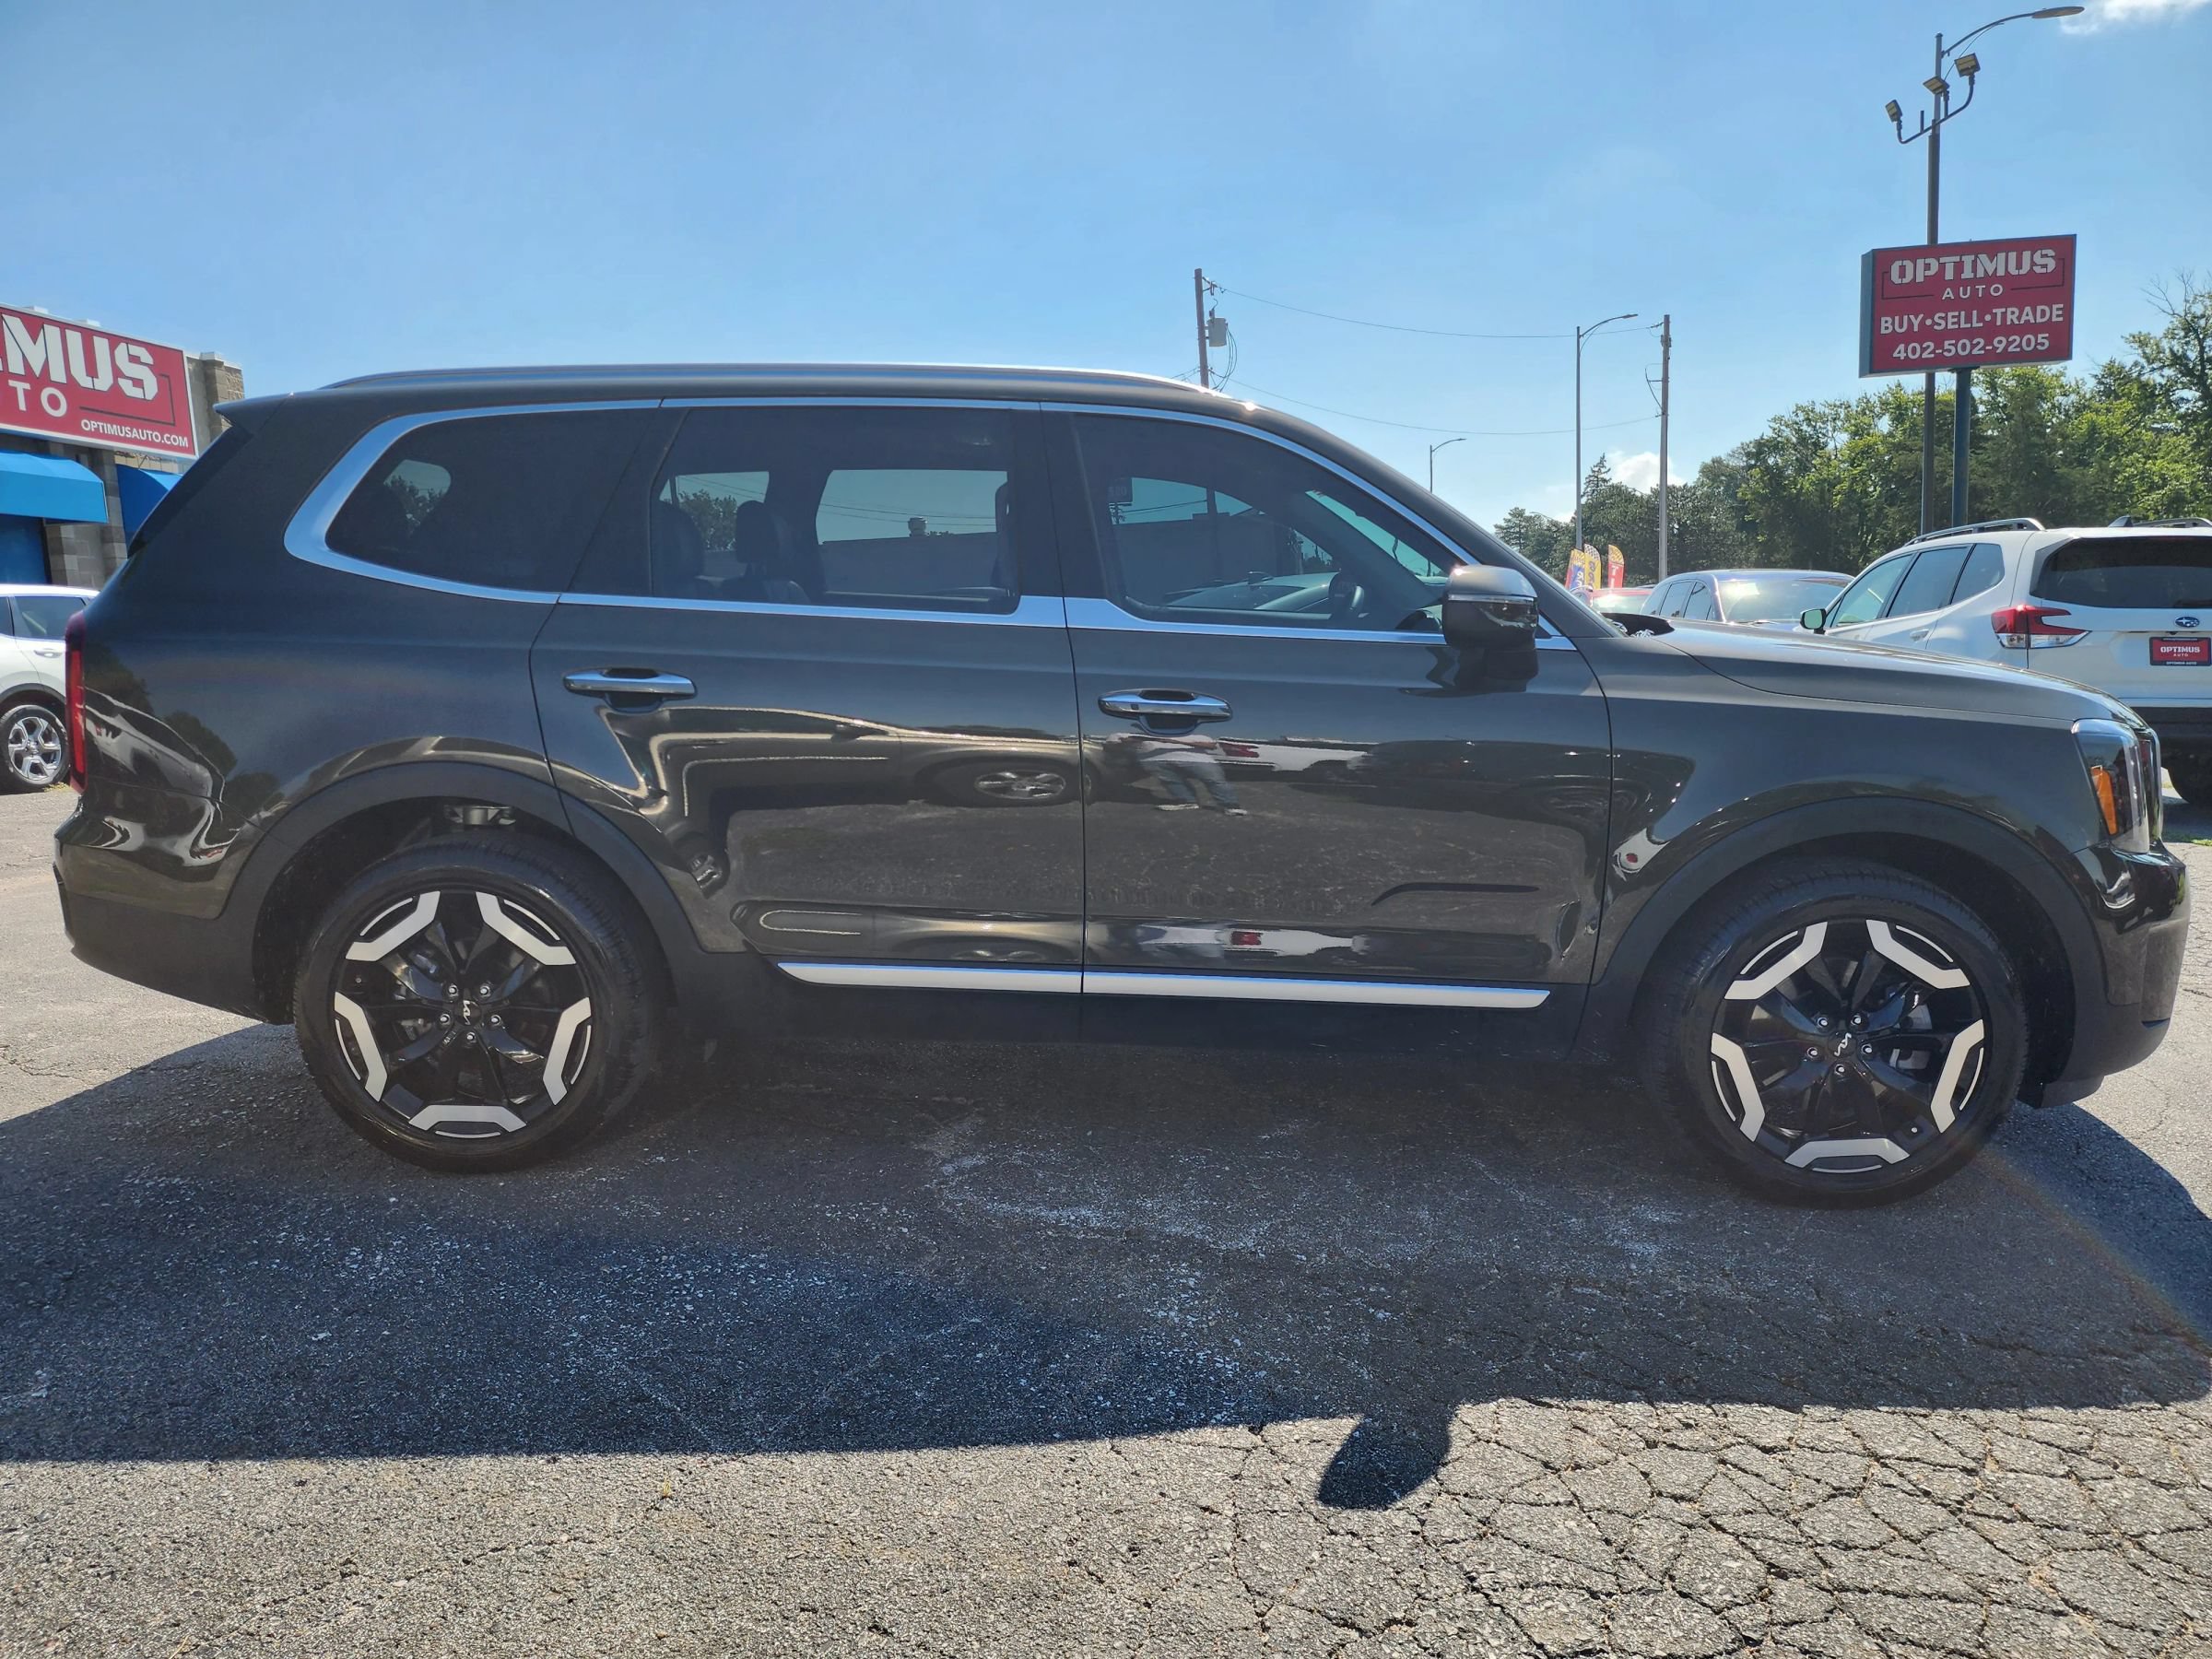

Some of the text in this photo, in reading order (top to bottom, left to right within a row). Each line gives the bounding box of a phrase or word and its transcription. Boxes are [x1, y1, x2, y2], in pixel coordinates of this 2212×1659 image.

[1890, 249, 2056, 284] OPTIMUS
[1942, 284, 2004, 300] AUTO
[0, 313, 159, 401] MUS
[1892, 334, 2050, 360] 402-502-9205
[8, 379, 67, 418] TO
[81, 418, 189, 449] OPTIMUSAUTO.COM
